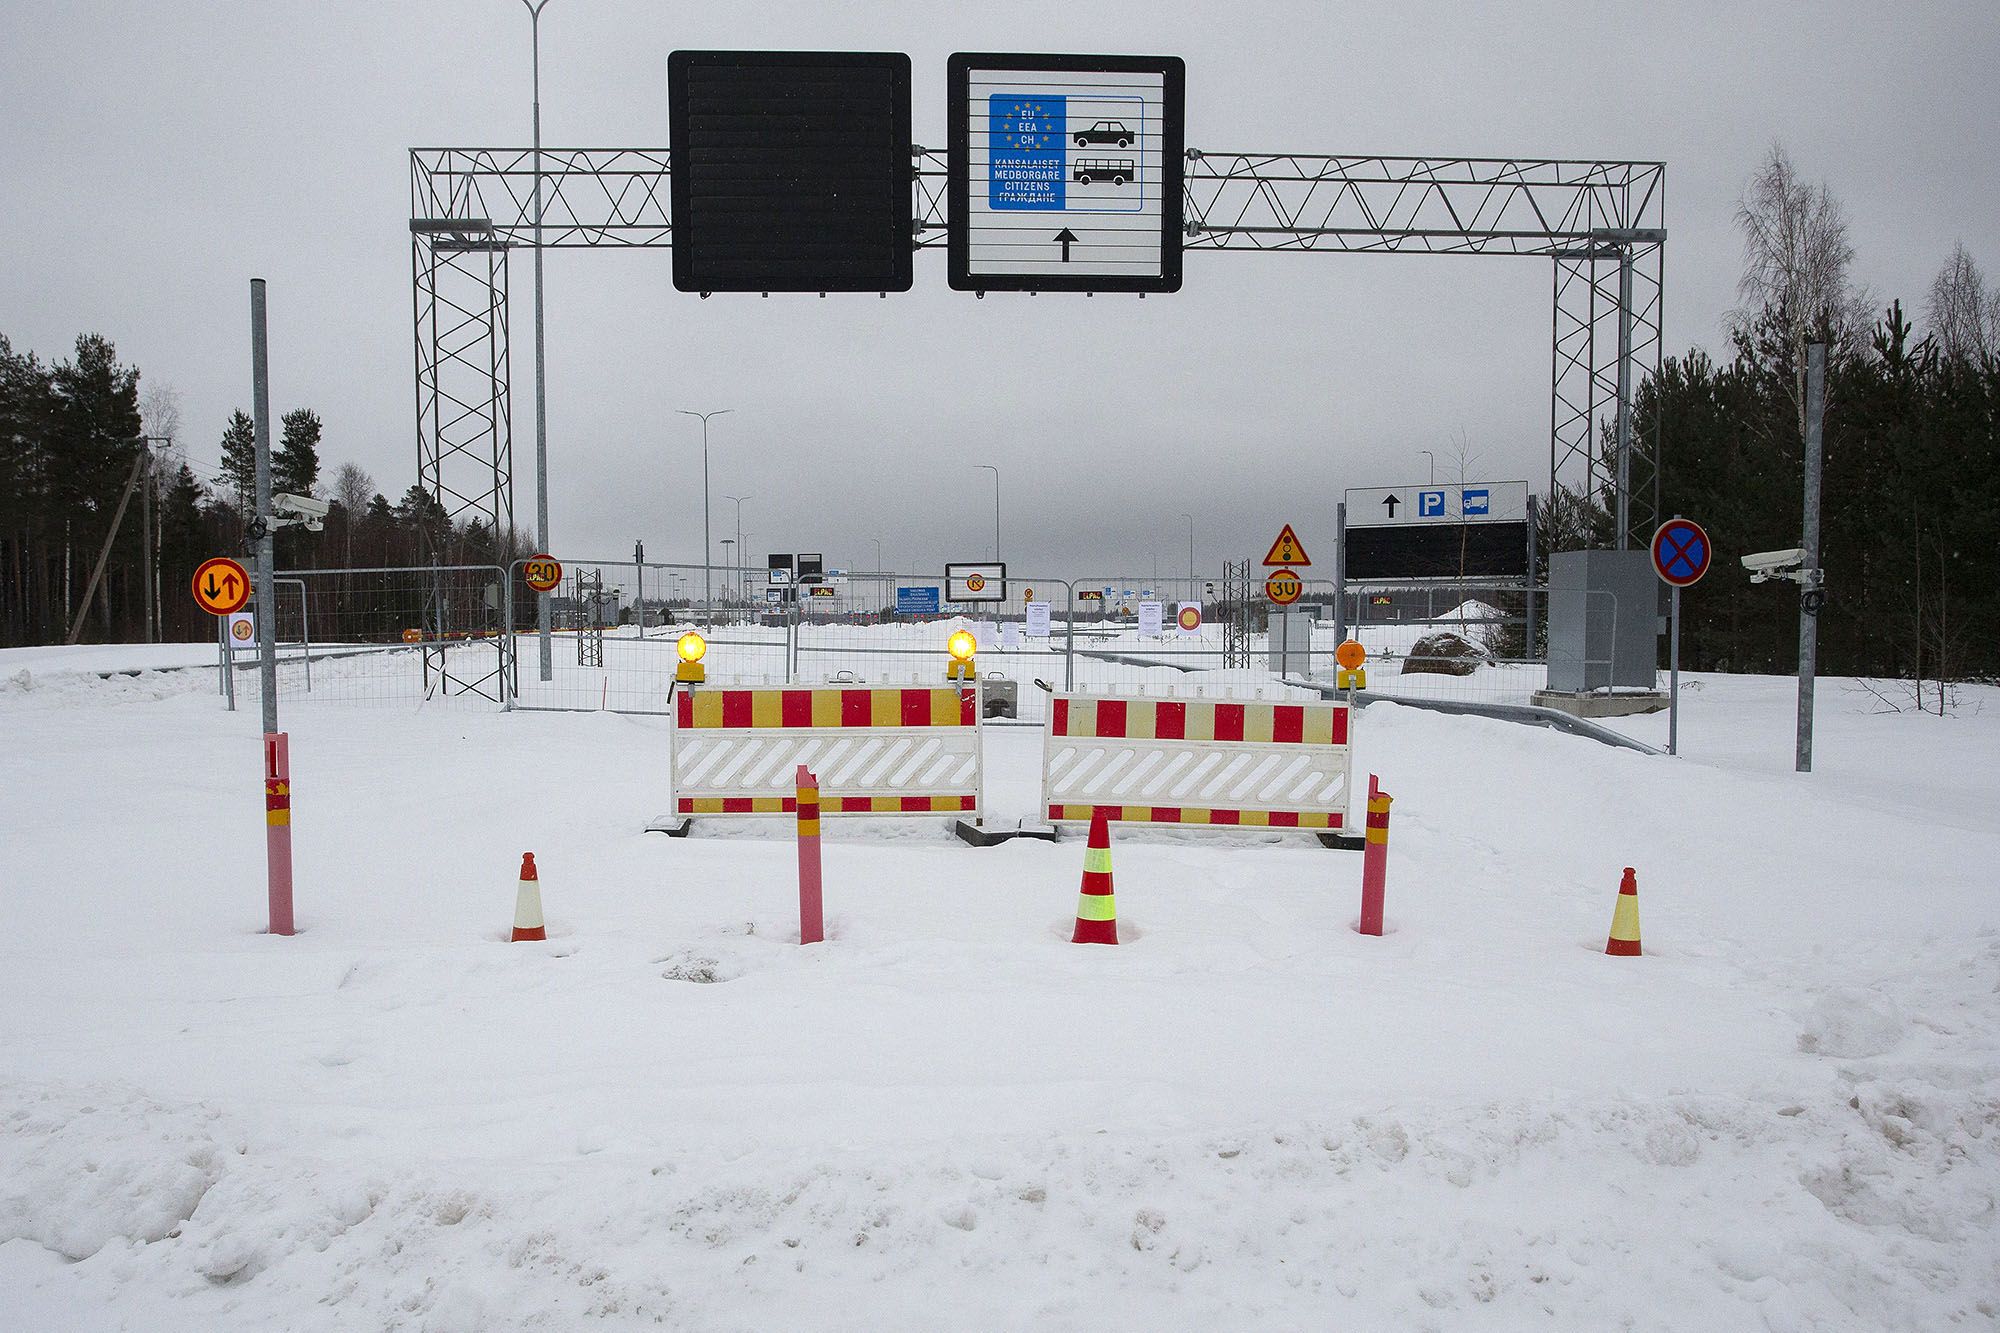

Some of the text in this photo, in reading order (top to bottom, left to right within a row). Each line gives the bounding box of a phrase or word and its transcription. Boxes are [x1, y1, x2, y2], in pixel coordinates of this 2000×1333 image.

[1021, 110, 1035, 120] EU
[1018, 122, 1037, 132] EEA
[1021, 135, 1034, 144] CH
[995, 159, 1060, 169] KANSALAISET
[995, 170, 1060, 180] MEDBORGARE
[1005, 181, 1050, 191] CITIZENS
[999, 192, 1056, 203] ГРАЖДАНЕ
[1272, 578, 1295, 597] 30
